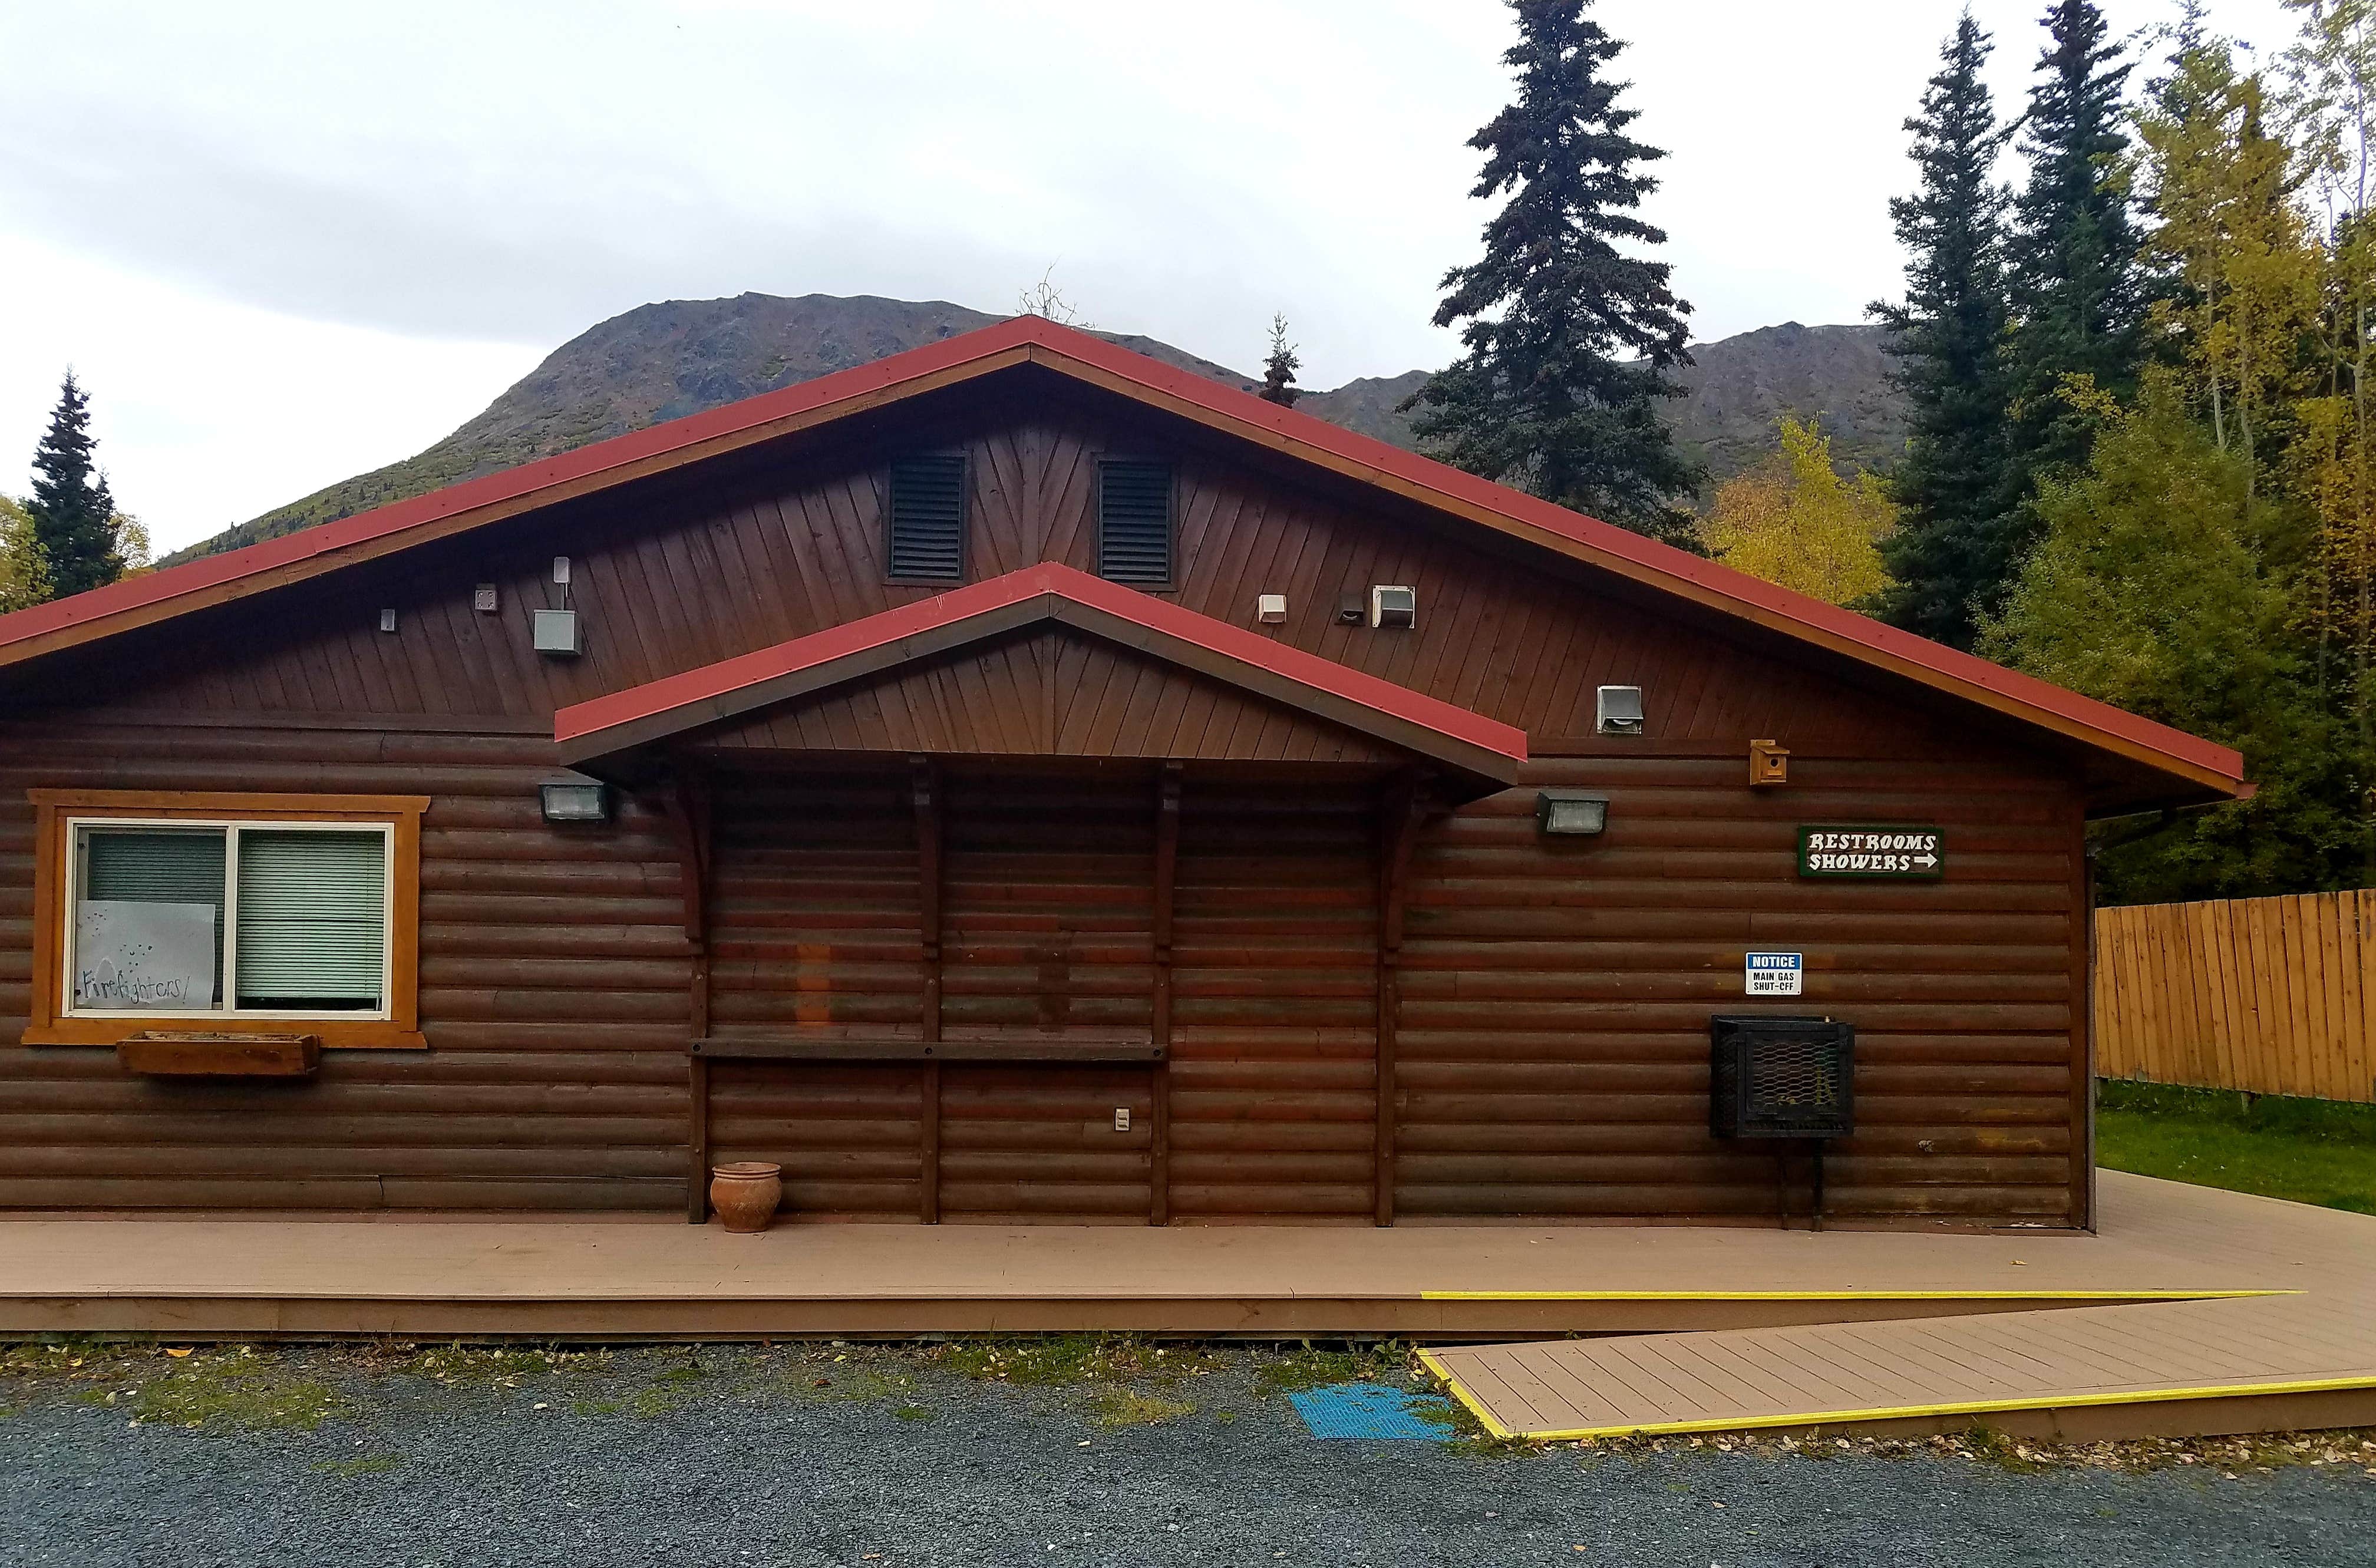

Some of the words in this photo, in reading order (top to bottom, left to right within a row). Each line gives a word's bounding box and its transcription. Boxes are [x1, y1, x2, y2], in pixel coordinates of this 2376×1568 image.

[1809, 833, 1936, 851] RESTROOMS
[1809, 854, 1910, 871] SHOWERS
[1753, 956, 1795, 968] NOTICE
[1753, 972, 1774, 981] MAIN
[1778, 972, 1794, 981] GAS
